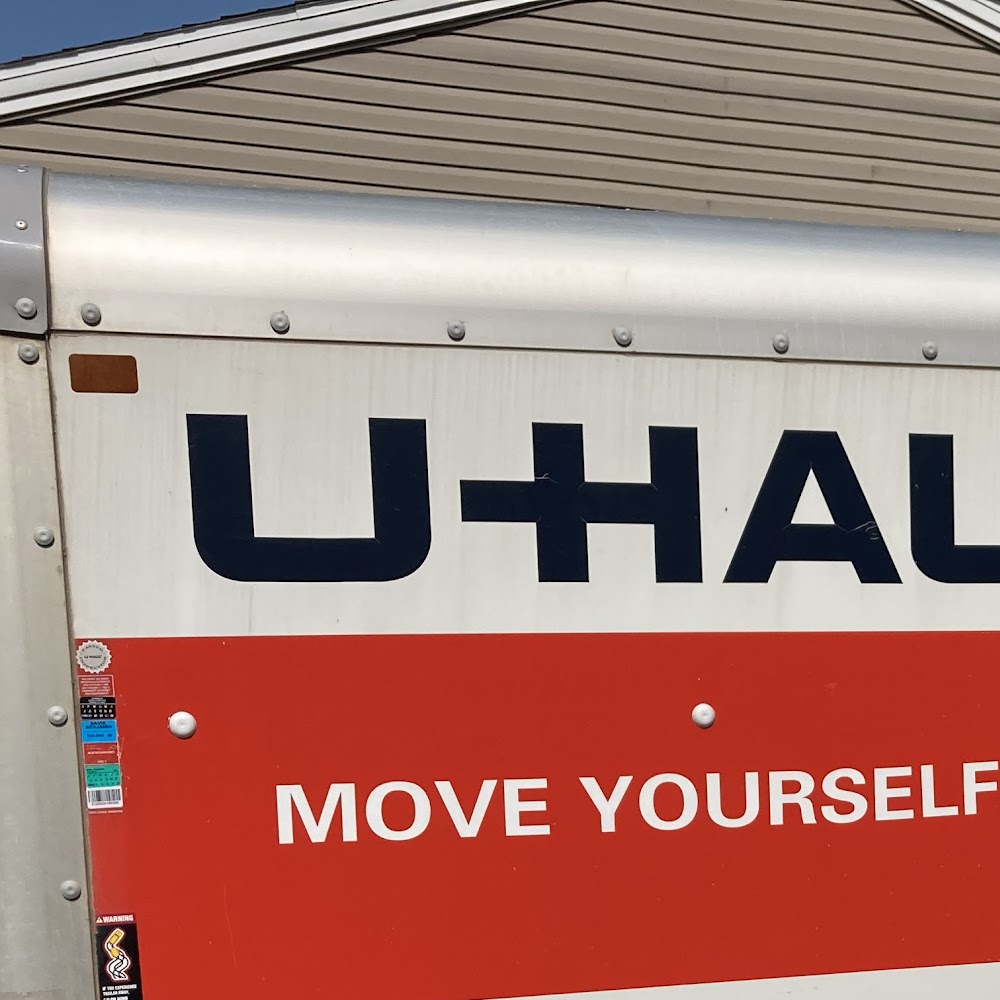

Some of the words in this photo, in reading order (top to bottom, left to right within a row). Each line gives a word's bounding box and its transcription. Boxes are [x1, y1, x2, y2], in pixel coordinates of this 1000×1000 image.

[275, 778, 551, 845] MOVE
[579, 760, 999, 833] YOURSELF
[102, 914, 134, 923] WARNING
